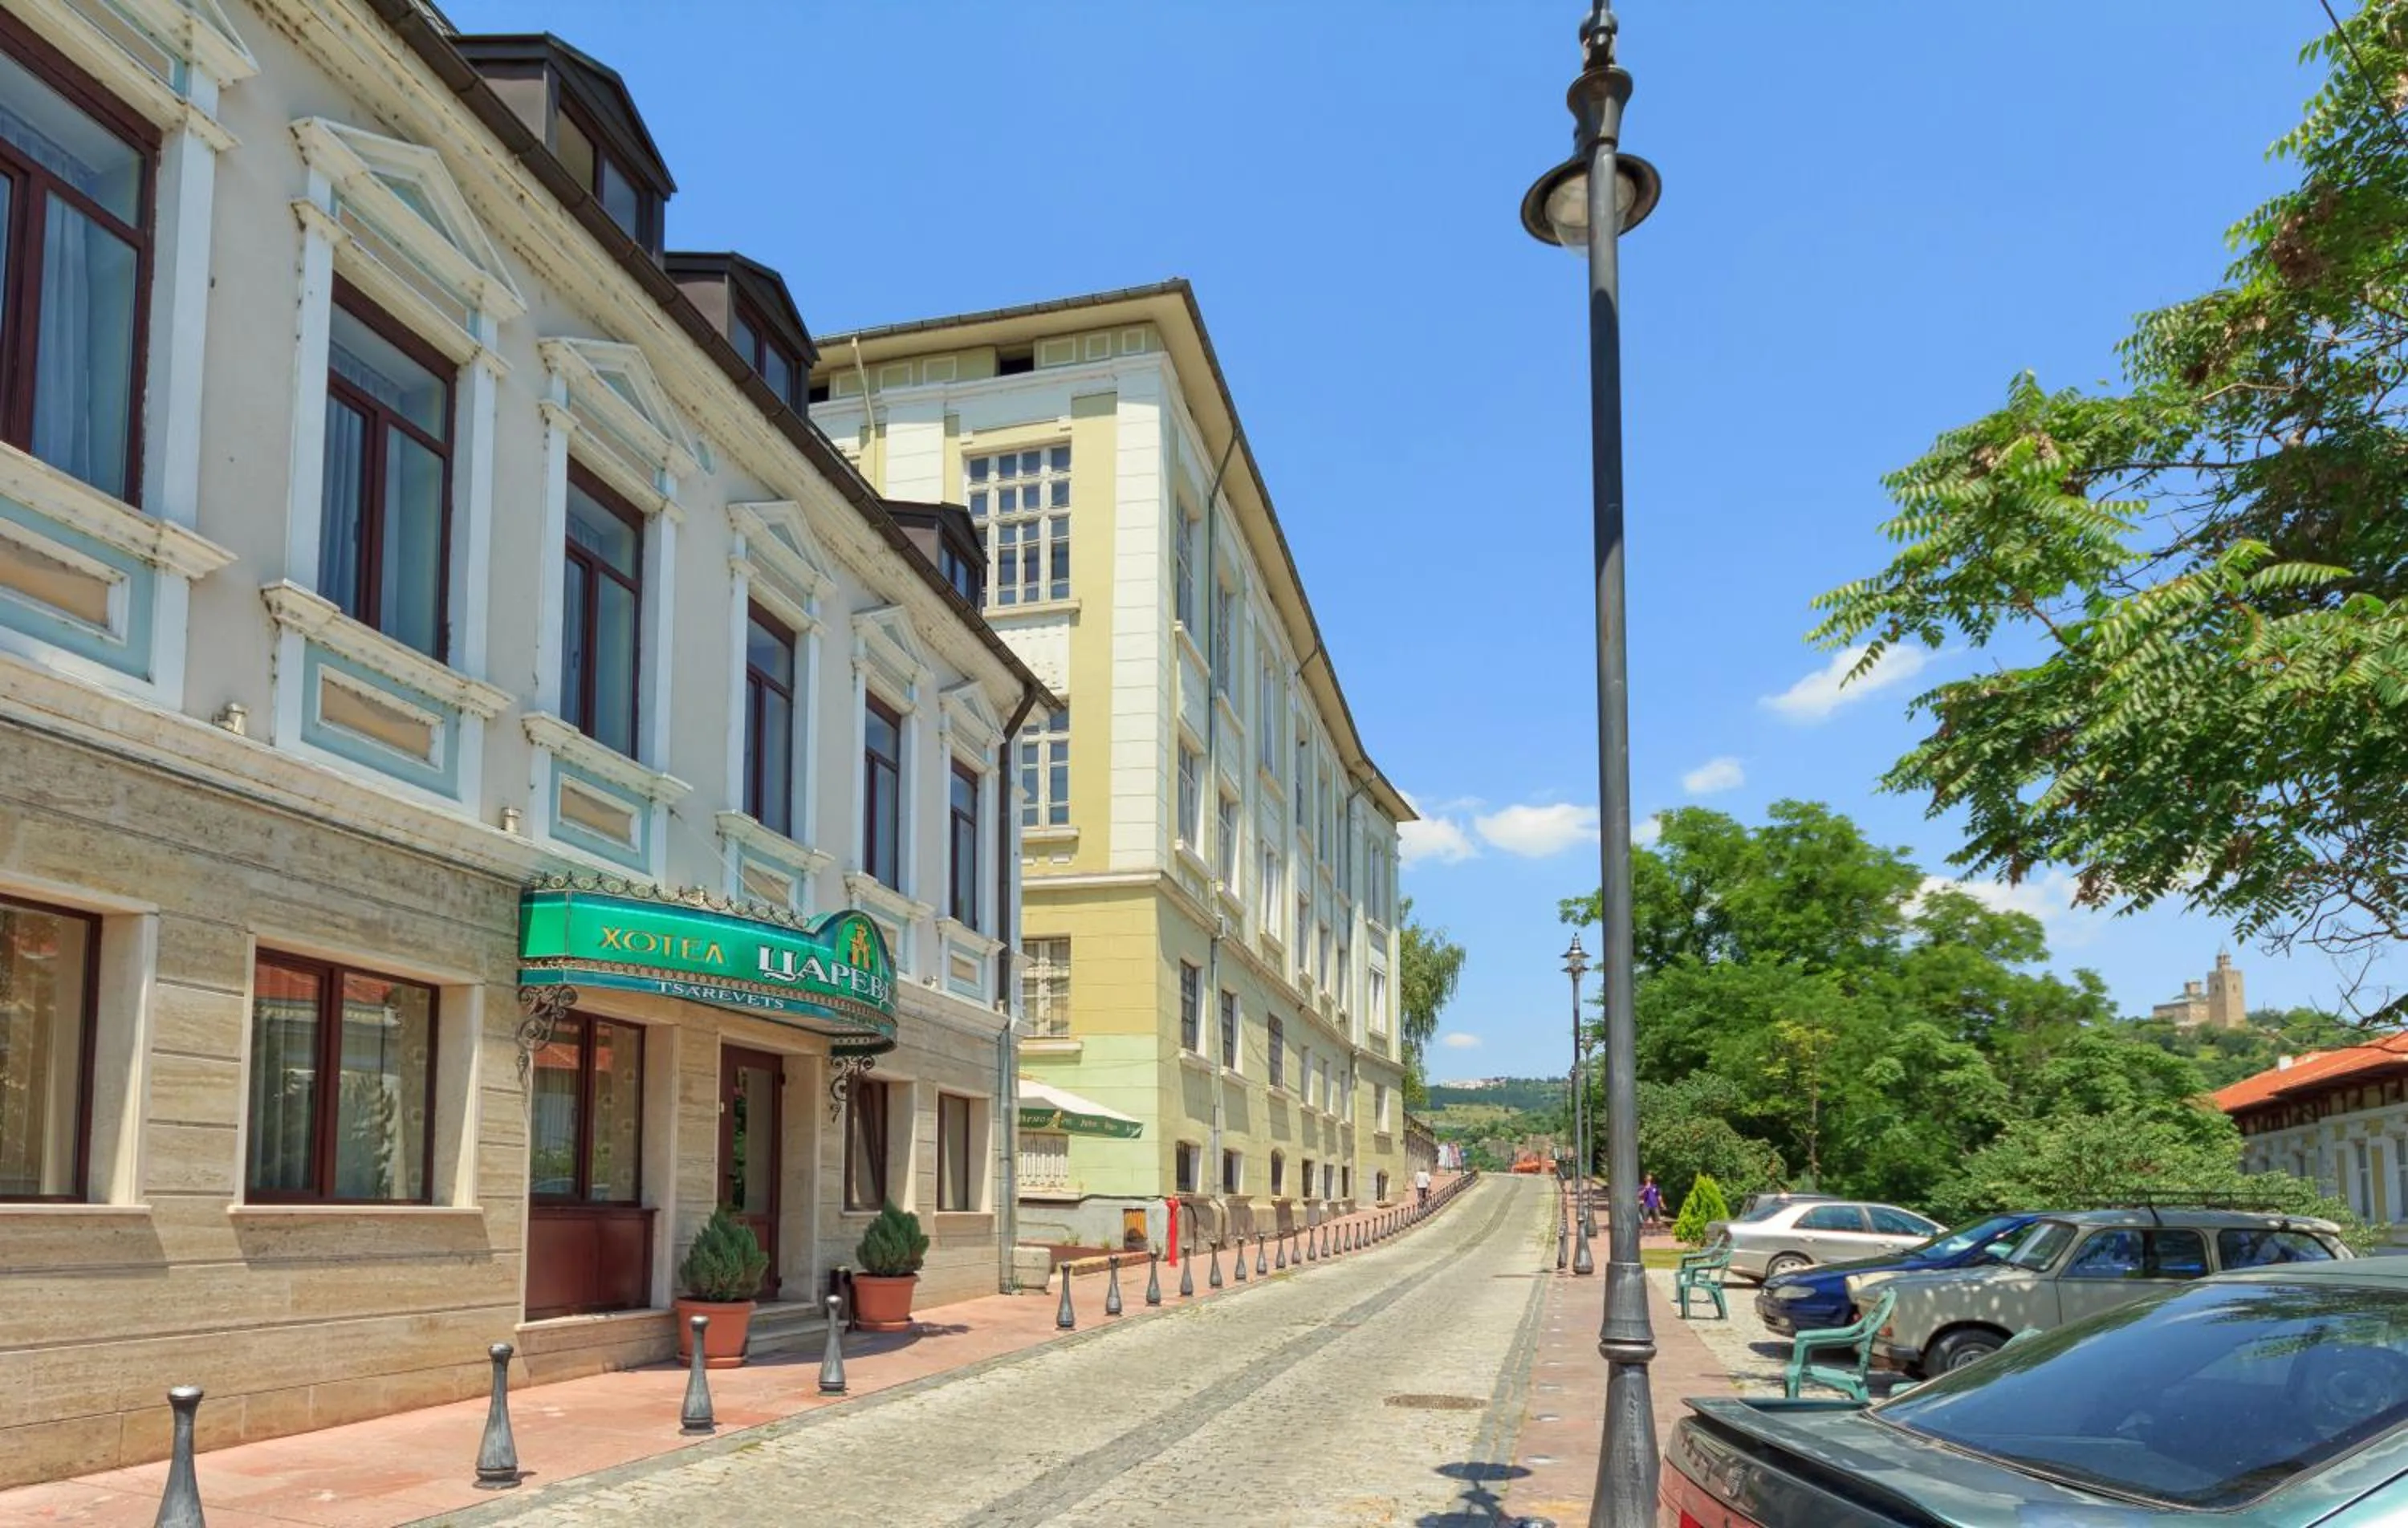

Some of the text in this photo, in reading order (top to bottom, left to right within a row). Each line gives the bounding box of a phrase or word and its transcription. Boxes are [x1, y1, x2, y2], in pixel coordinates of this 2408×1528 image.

[600, 926, 891, 1003] ХОТЕЛ ЦАРЕВ
[657, 981, 785, 1010] TSAREVETS
